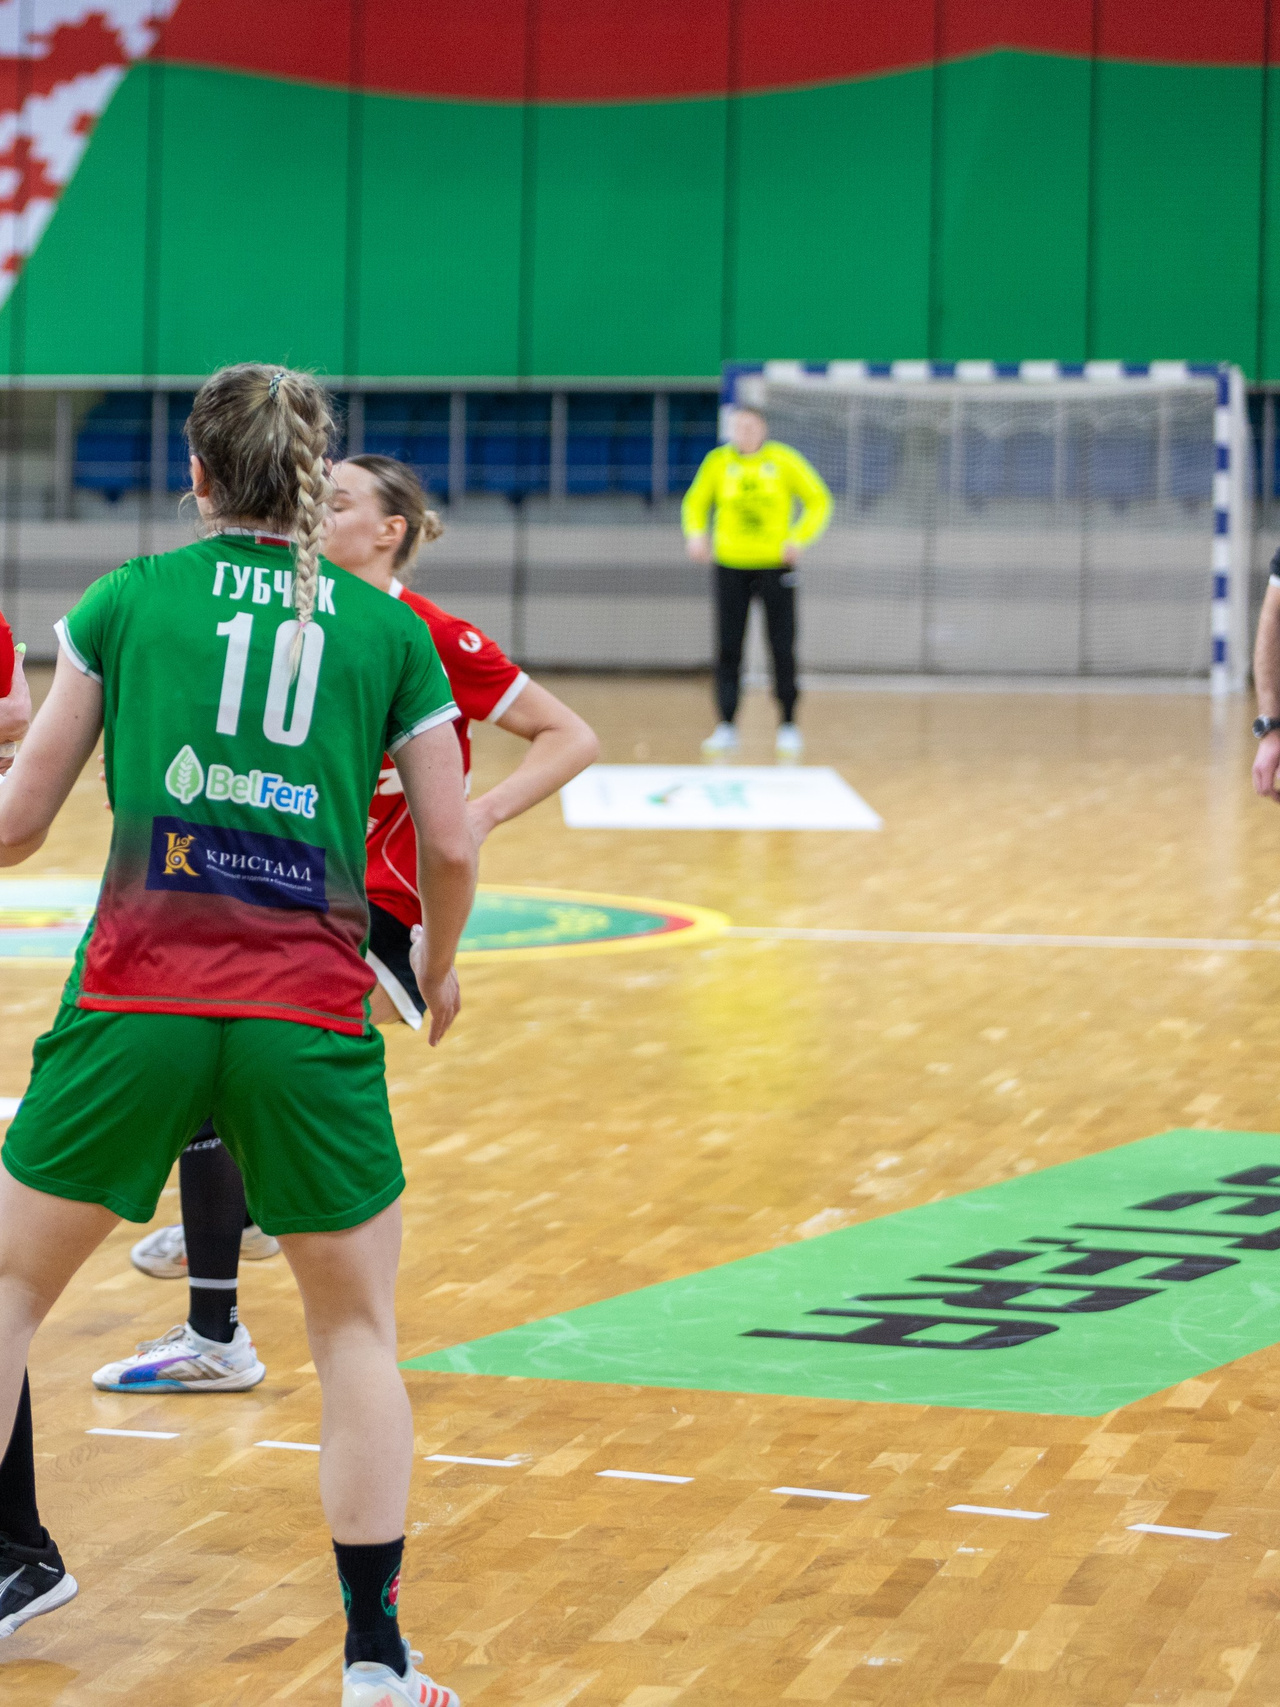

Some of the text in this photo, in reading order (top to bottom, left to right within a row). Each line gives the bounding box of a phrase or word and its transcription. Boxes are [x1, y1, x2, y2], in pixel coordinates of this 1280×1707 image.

[212, 561, 336, 615] ГУБЧК
[216, 611, 325, 747] 10
[207, 766, 317, 817] BelFert
[206, 849, 312, 882] КРИСТАЛЛ
